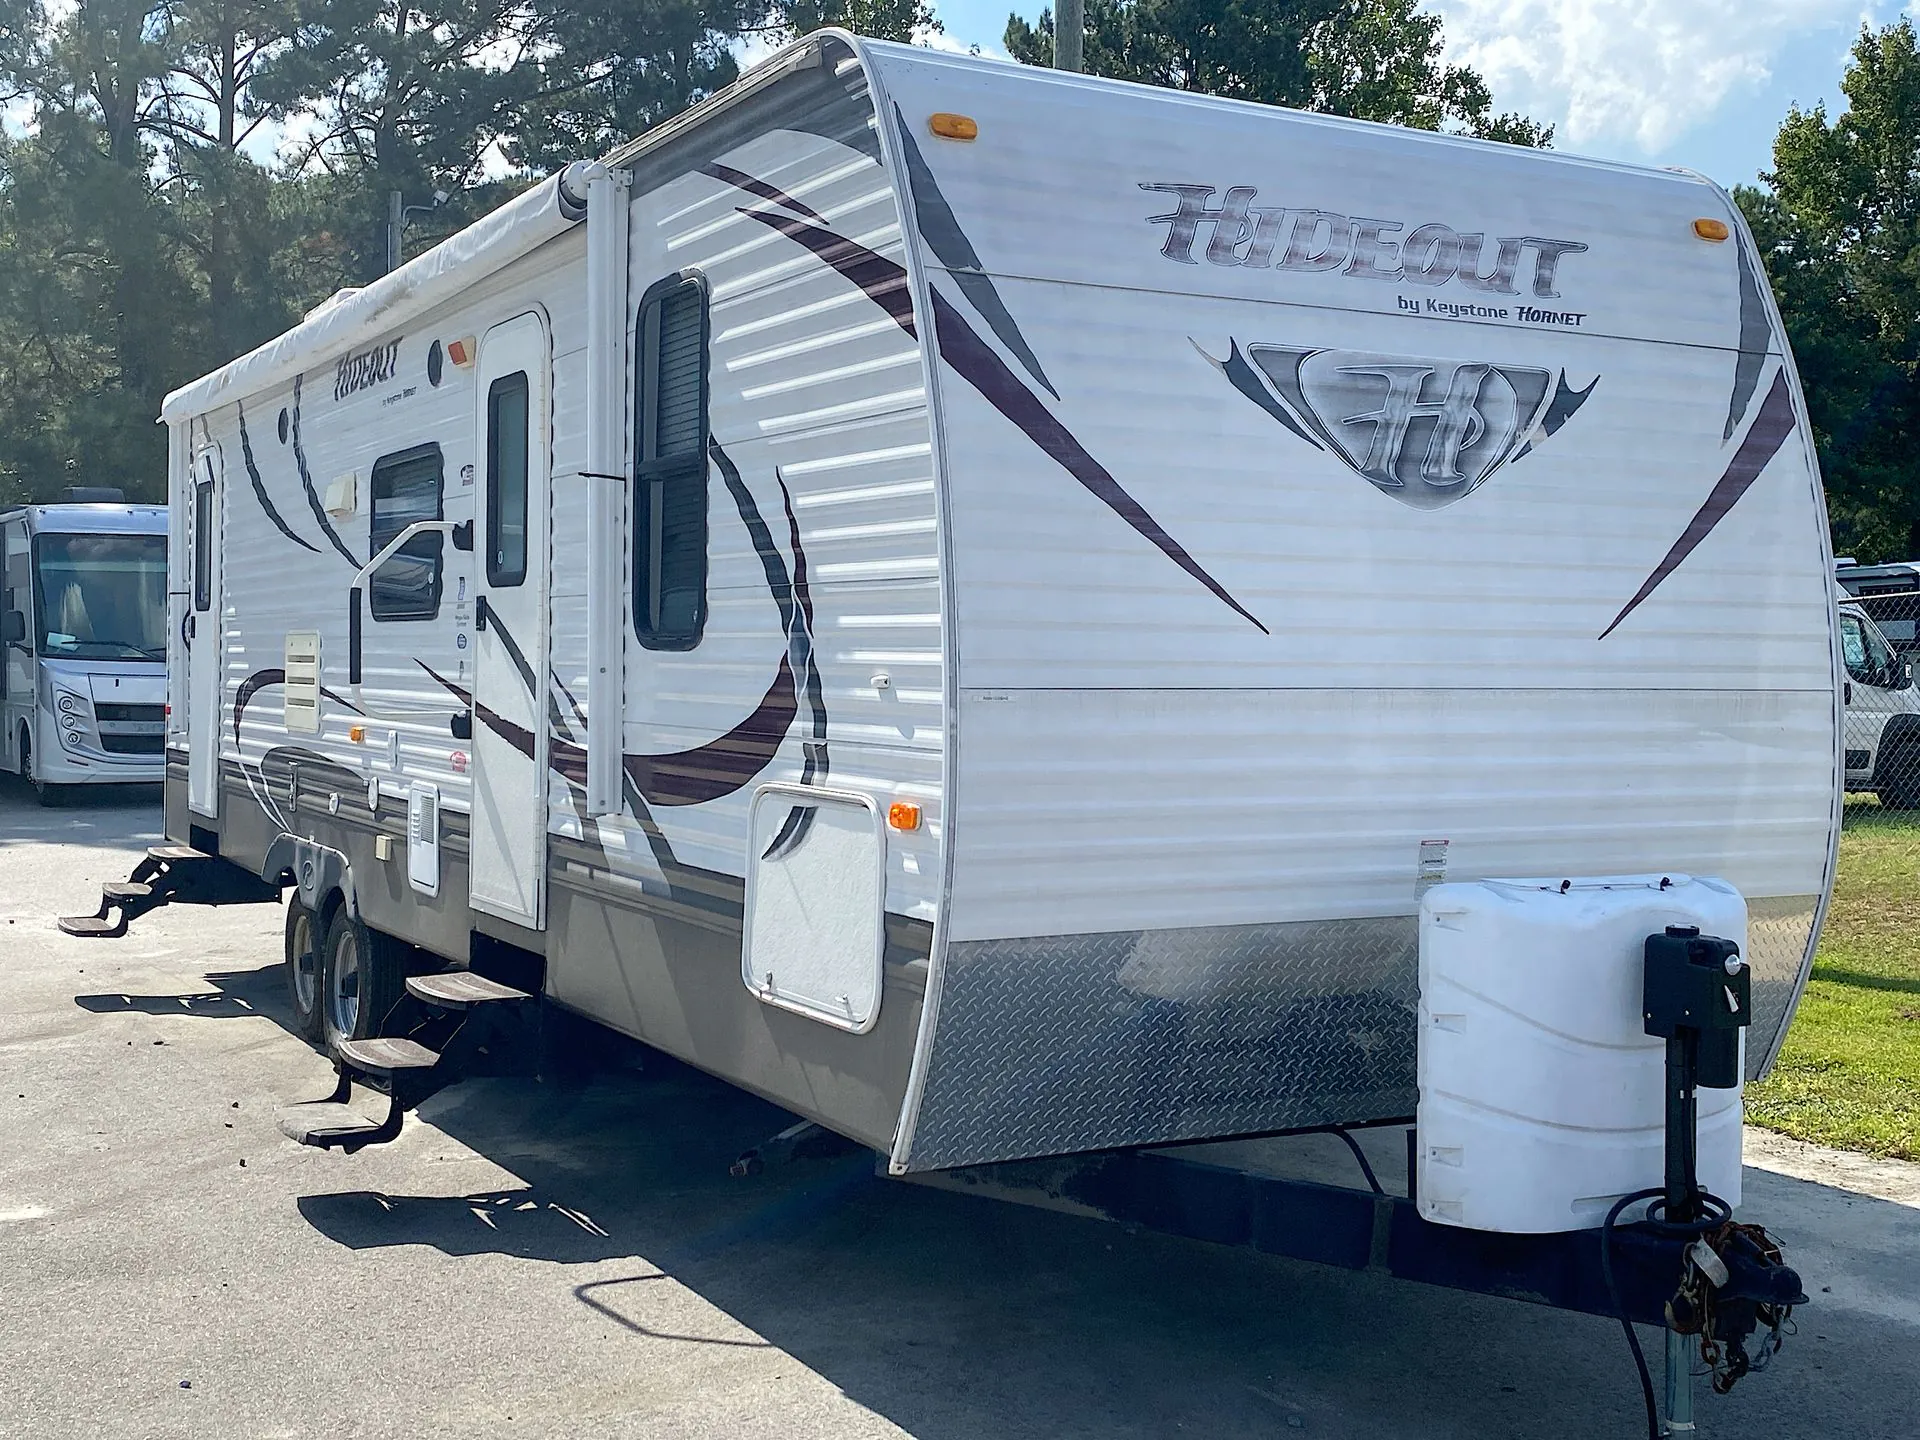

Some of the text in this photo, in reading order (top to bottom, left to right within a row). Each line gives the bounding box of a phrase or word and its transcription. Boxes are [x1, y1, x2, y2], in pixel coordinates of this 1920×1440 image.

[1138, 183, 1589, 299] HIDEOUT
[1397, 295, 1588, 327] by Keystone HORNET
[334, 335, 404, 402] HIDEOUT
